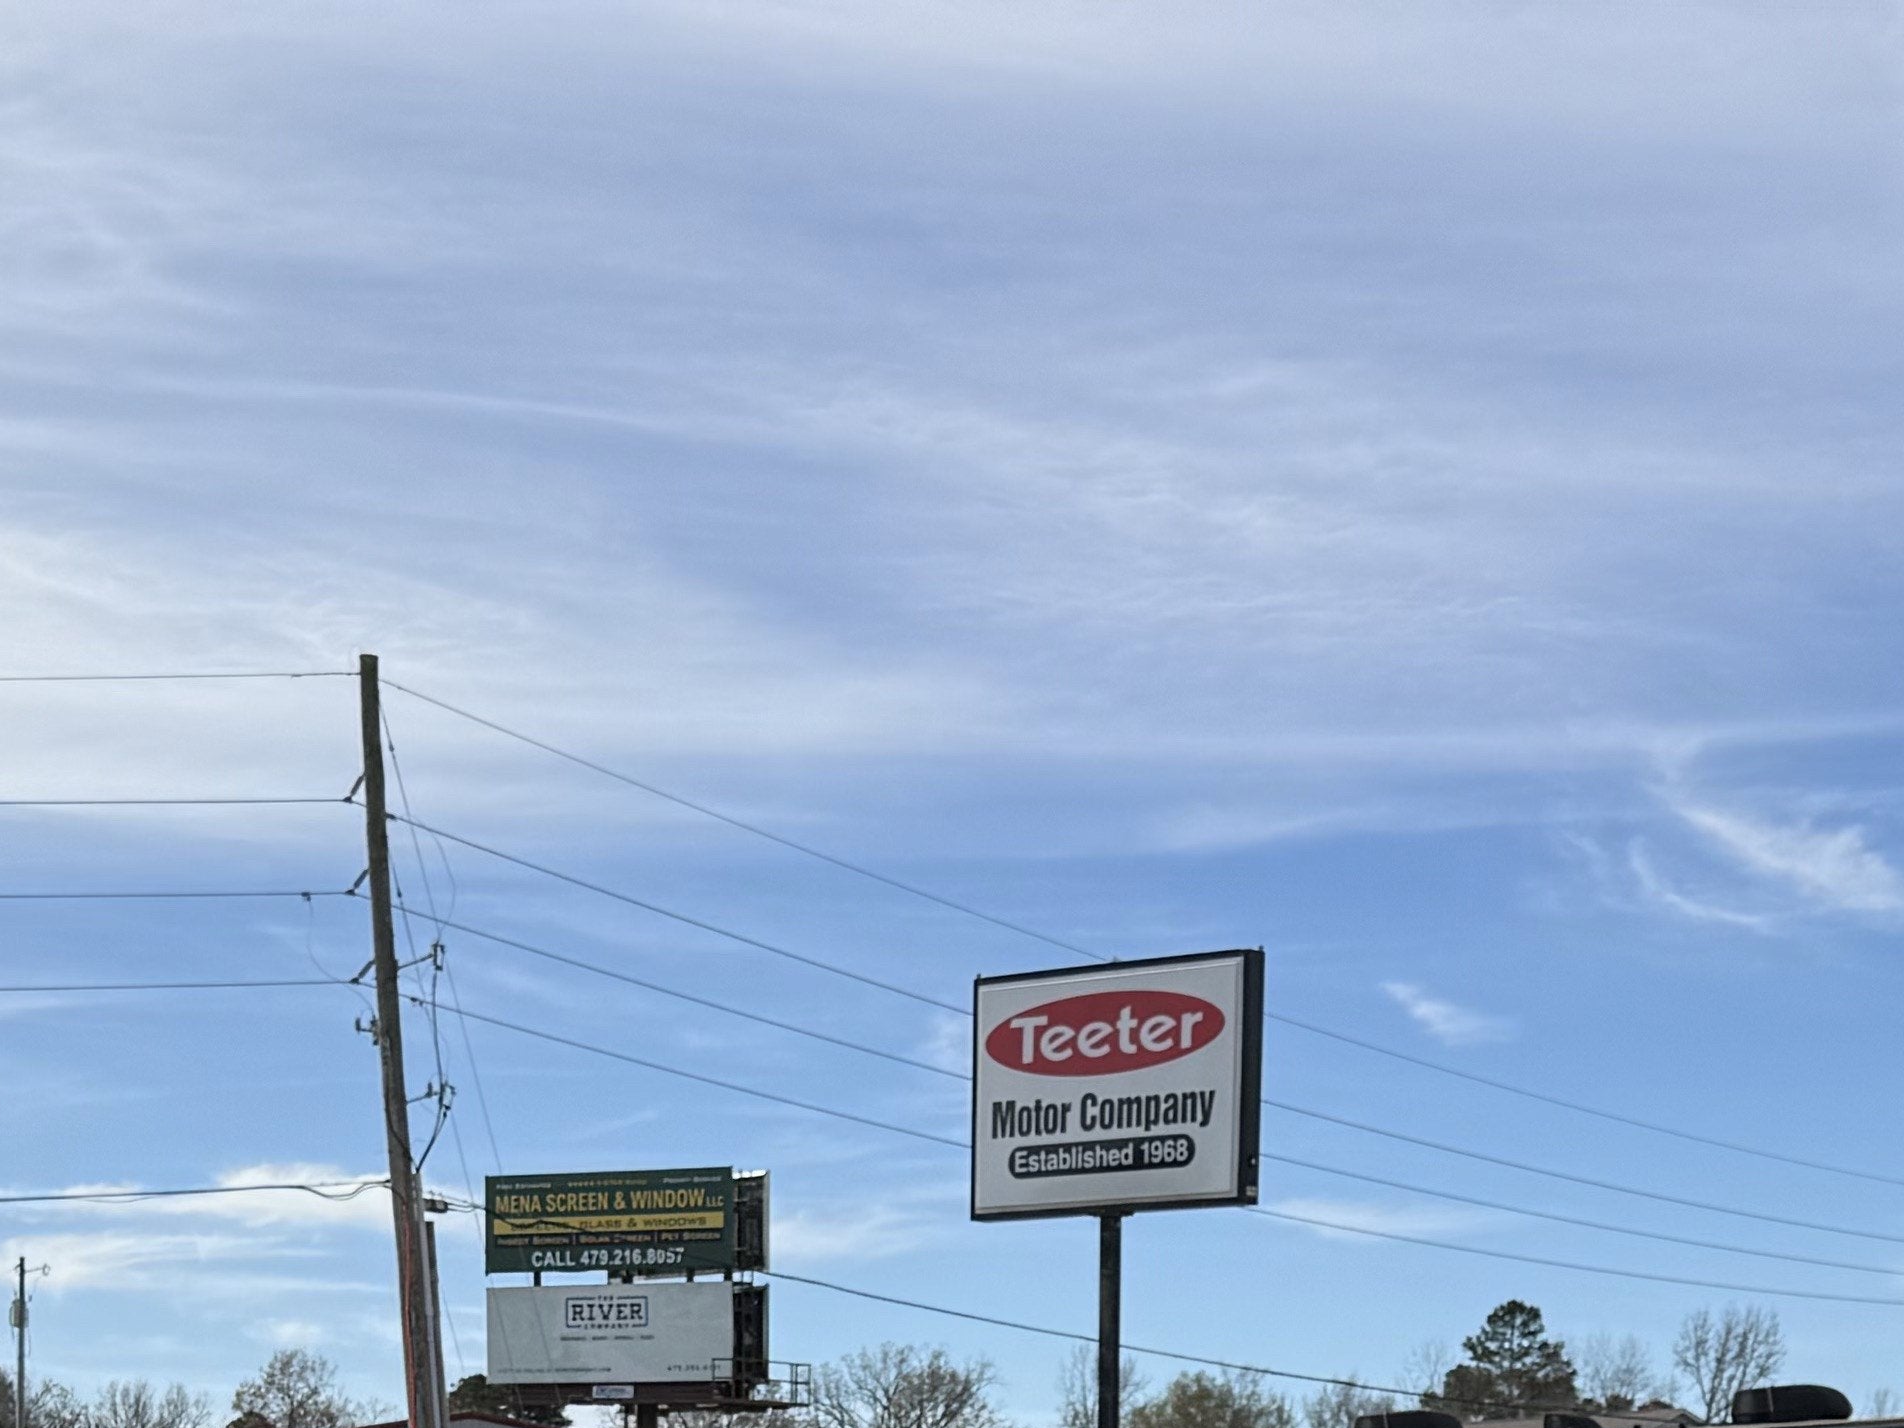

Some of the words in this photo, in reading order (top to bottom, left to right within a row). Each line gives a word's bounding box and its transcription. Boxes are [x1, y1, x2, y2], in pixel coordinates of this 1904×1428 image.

[1010, 1006, 1204, 1064] Teeter
[992, 1099, 1072, 1139] Motor
[1080, 1091, 1215, 1132] Company
[1014, 1142, 1134, 1173] Established
[1140, 1139, 1189, 1164] 1968
[496, 1195, 542, 1214] MENA
[546, 1192, 609, 1213] SCREEN
[614, 1192, 626, 1209] &
[630, 1188, 706, 1209] WINDOW
[706, 1196, 725, 1207] LLC
[531, 1251, 575, 1268] CALL
[580, 1248, 685, 1266] 479.216.8057
[572, 1303, 643, 1321] RIVER
